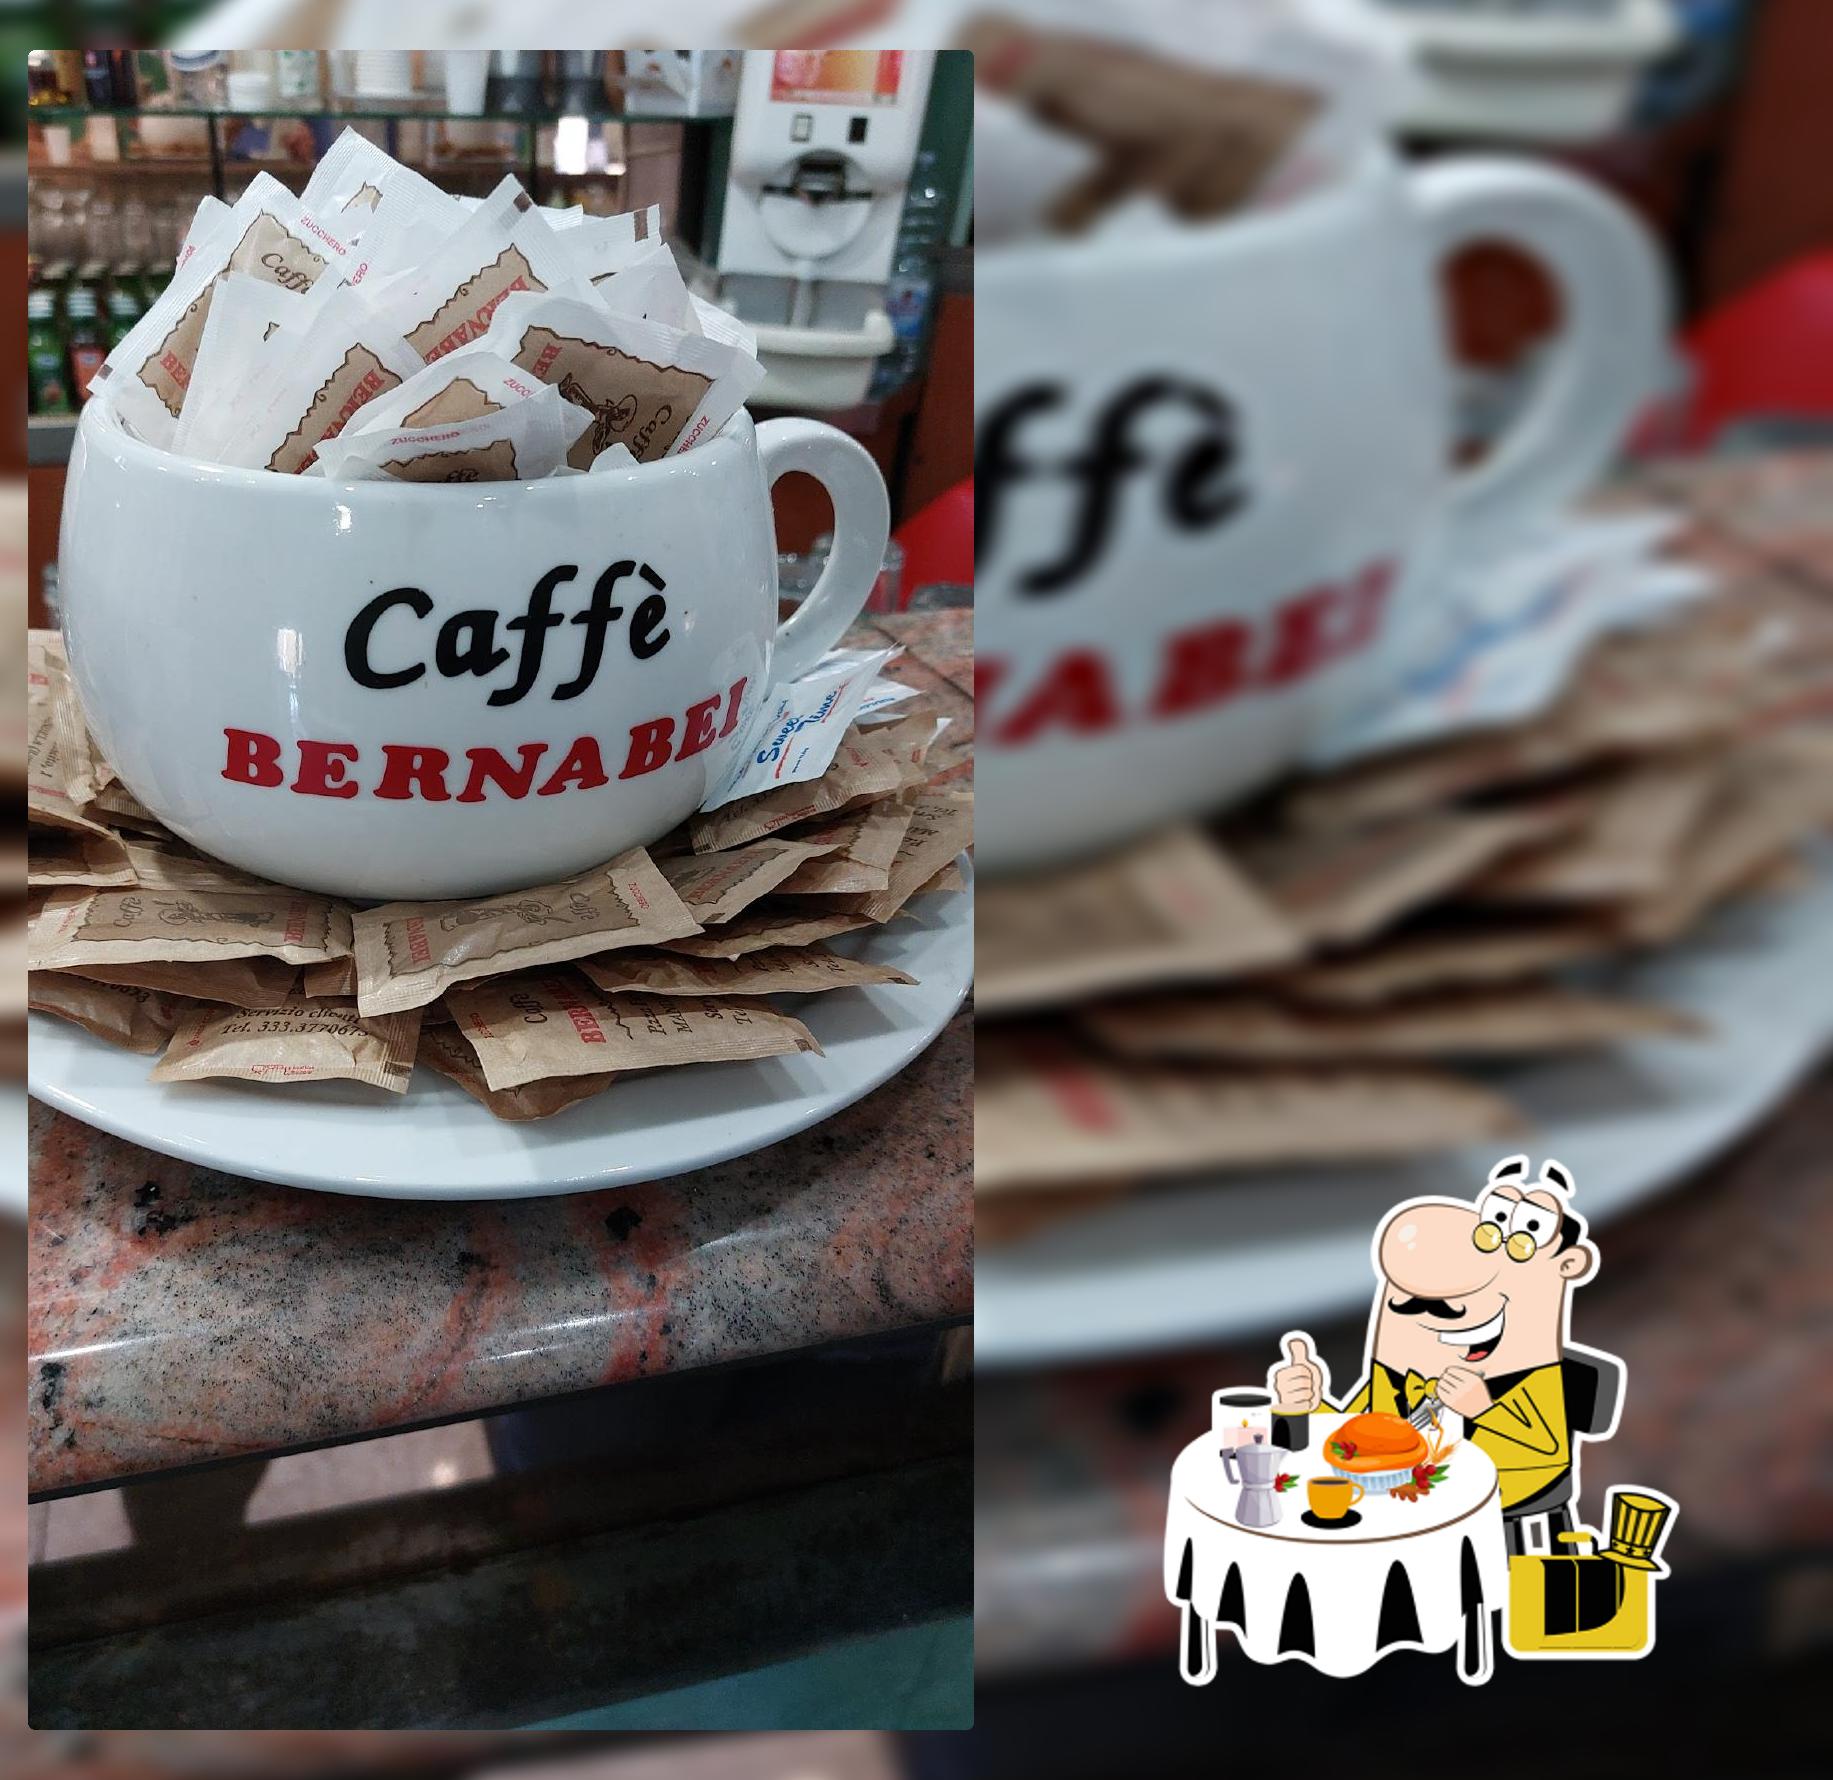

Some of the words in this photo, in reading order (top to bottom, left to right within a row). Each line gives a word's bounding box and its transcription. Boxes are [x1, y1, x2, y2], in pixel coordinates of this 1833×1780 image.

[300, 215, 346, 256] ZUCCHERO
[260, 253, 314, 294] Caff
[503, 377, 536, 399] ZUCC
[632, 404, 673, 463] Caff
[344, 560, 670, 706] Caffè
[221, 677, 748, 803] BERNABEI
[220, 1021, 250, 1035] Tel.
[234, 1004, 304, 1019] Servizio
